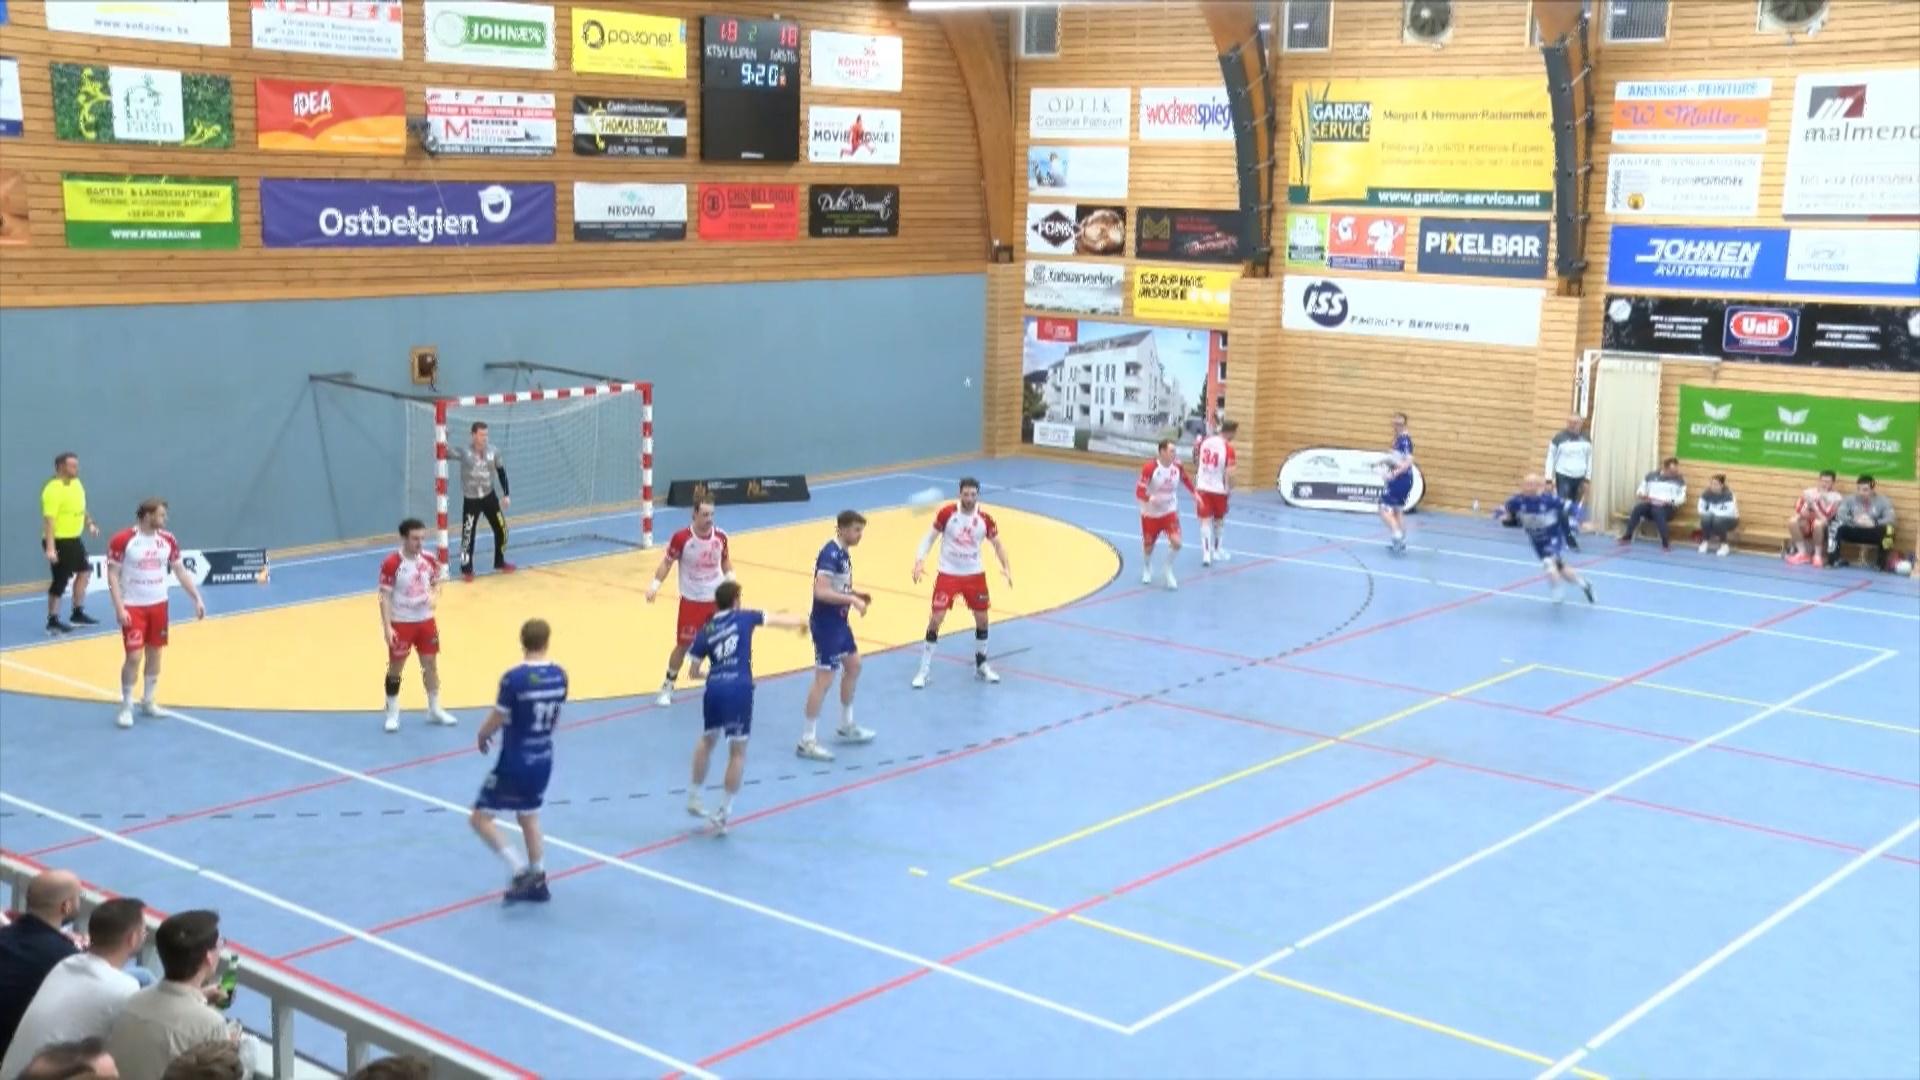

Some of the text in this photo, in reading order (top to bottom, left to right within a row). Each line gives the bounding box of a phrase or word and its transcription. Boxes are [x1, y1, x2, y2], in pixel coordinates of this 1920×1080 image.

[293, 89, 333, 116] IDEA
[1146, 96, 1233, 131] wochenspieg
[1313, 103, 1373, 121] GARDEN
[1312, 121, 1371, 139] SERVICE
[1378, 188, 1540, 206] www.garden-service.net
[318, 204, 480, 243] Ostbelgien
[1425, 231, 1542, 257] PIXELBAR
[1635, 238, 1762, 263] JOHNEN
[1306, 289, 1346, 315] ISS
[1763, 427, 1818, 445] erima
[1202, 448, 1219, 468] 34
